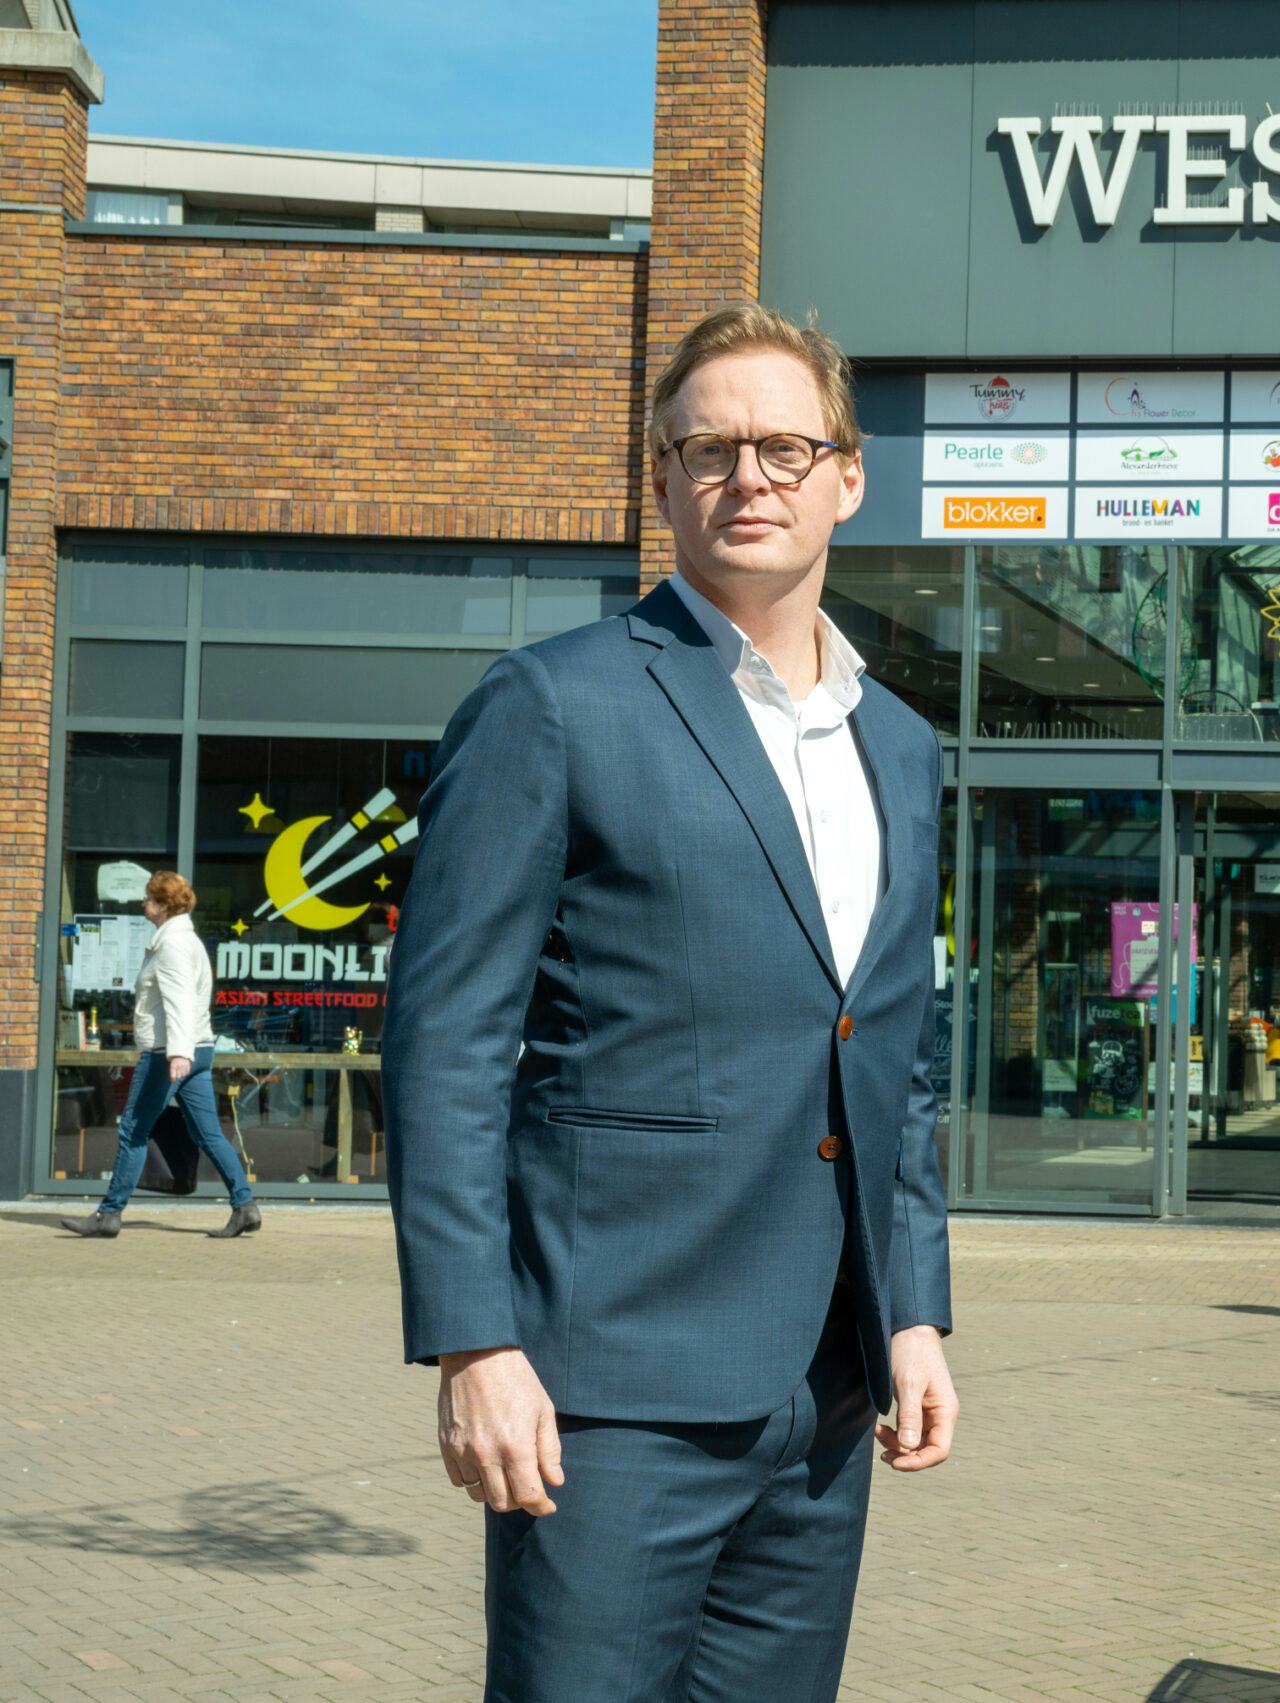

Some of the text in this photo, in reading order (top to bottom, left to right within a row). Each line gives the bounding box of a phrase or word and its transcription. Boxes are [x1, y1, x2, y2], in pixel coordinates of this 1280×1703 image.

[969, 384, 1026, 401] Tummy
[1143, 408, 1169, 418] Flower
[1171, 408, 1196, 417] Decor
[944, 443, 1003, 460] Pearle
[1096, 499, 1201, 517] HULLEMAN
[216, 941, 388, 982] MOONLI
[215, 989, 378, 1008] ASIAN STREETFOOD
